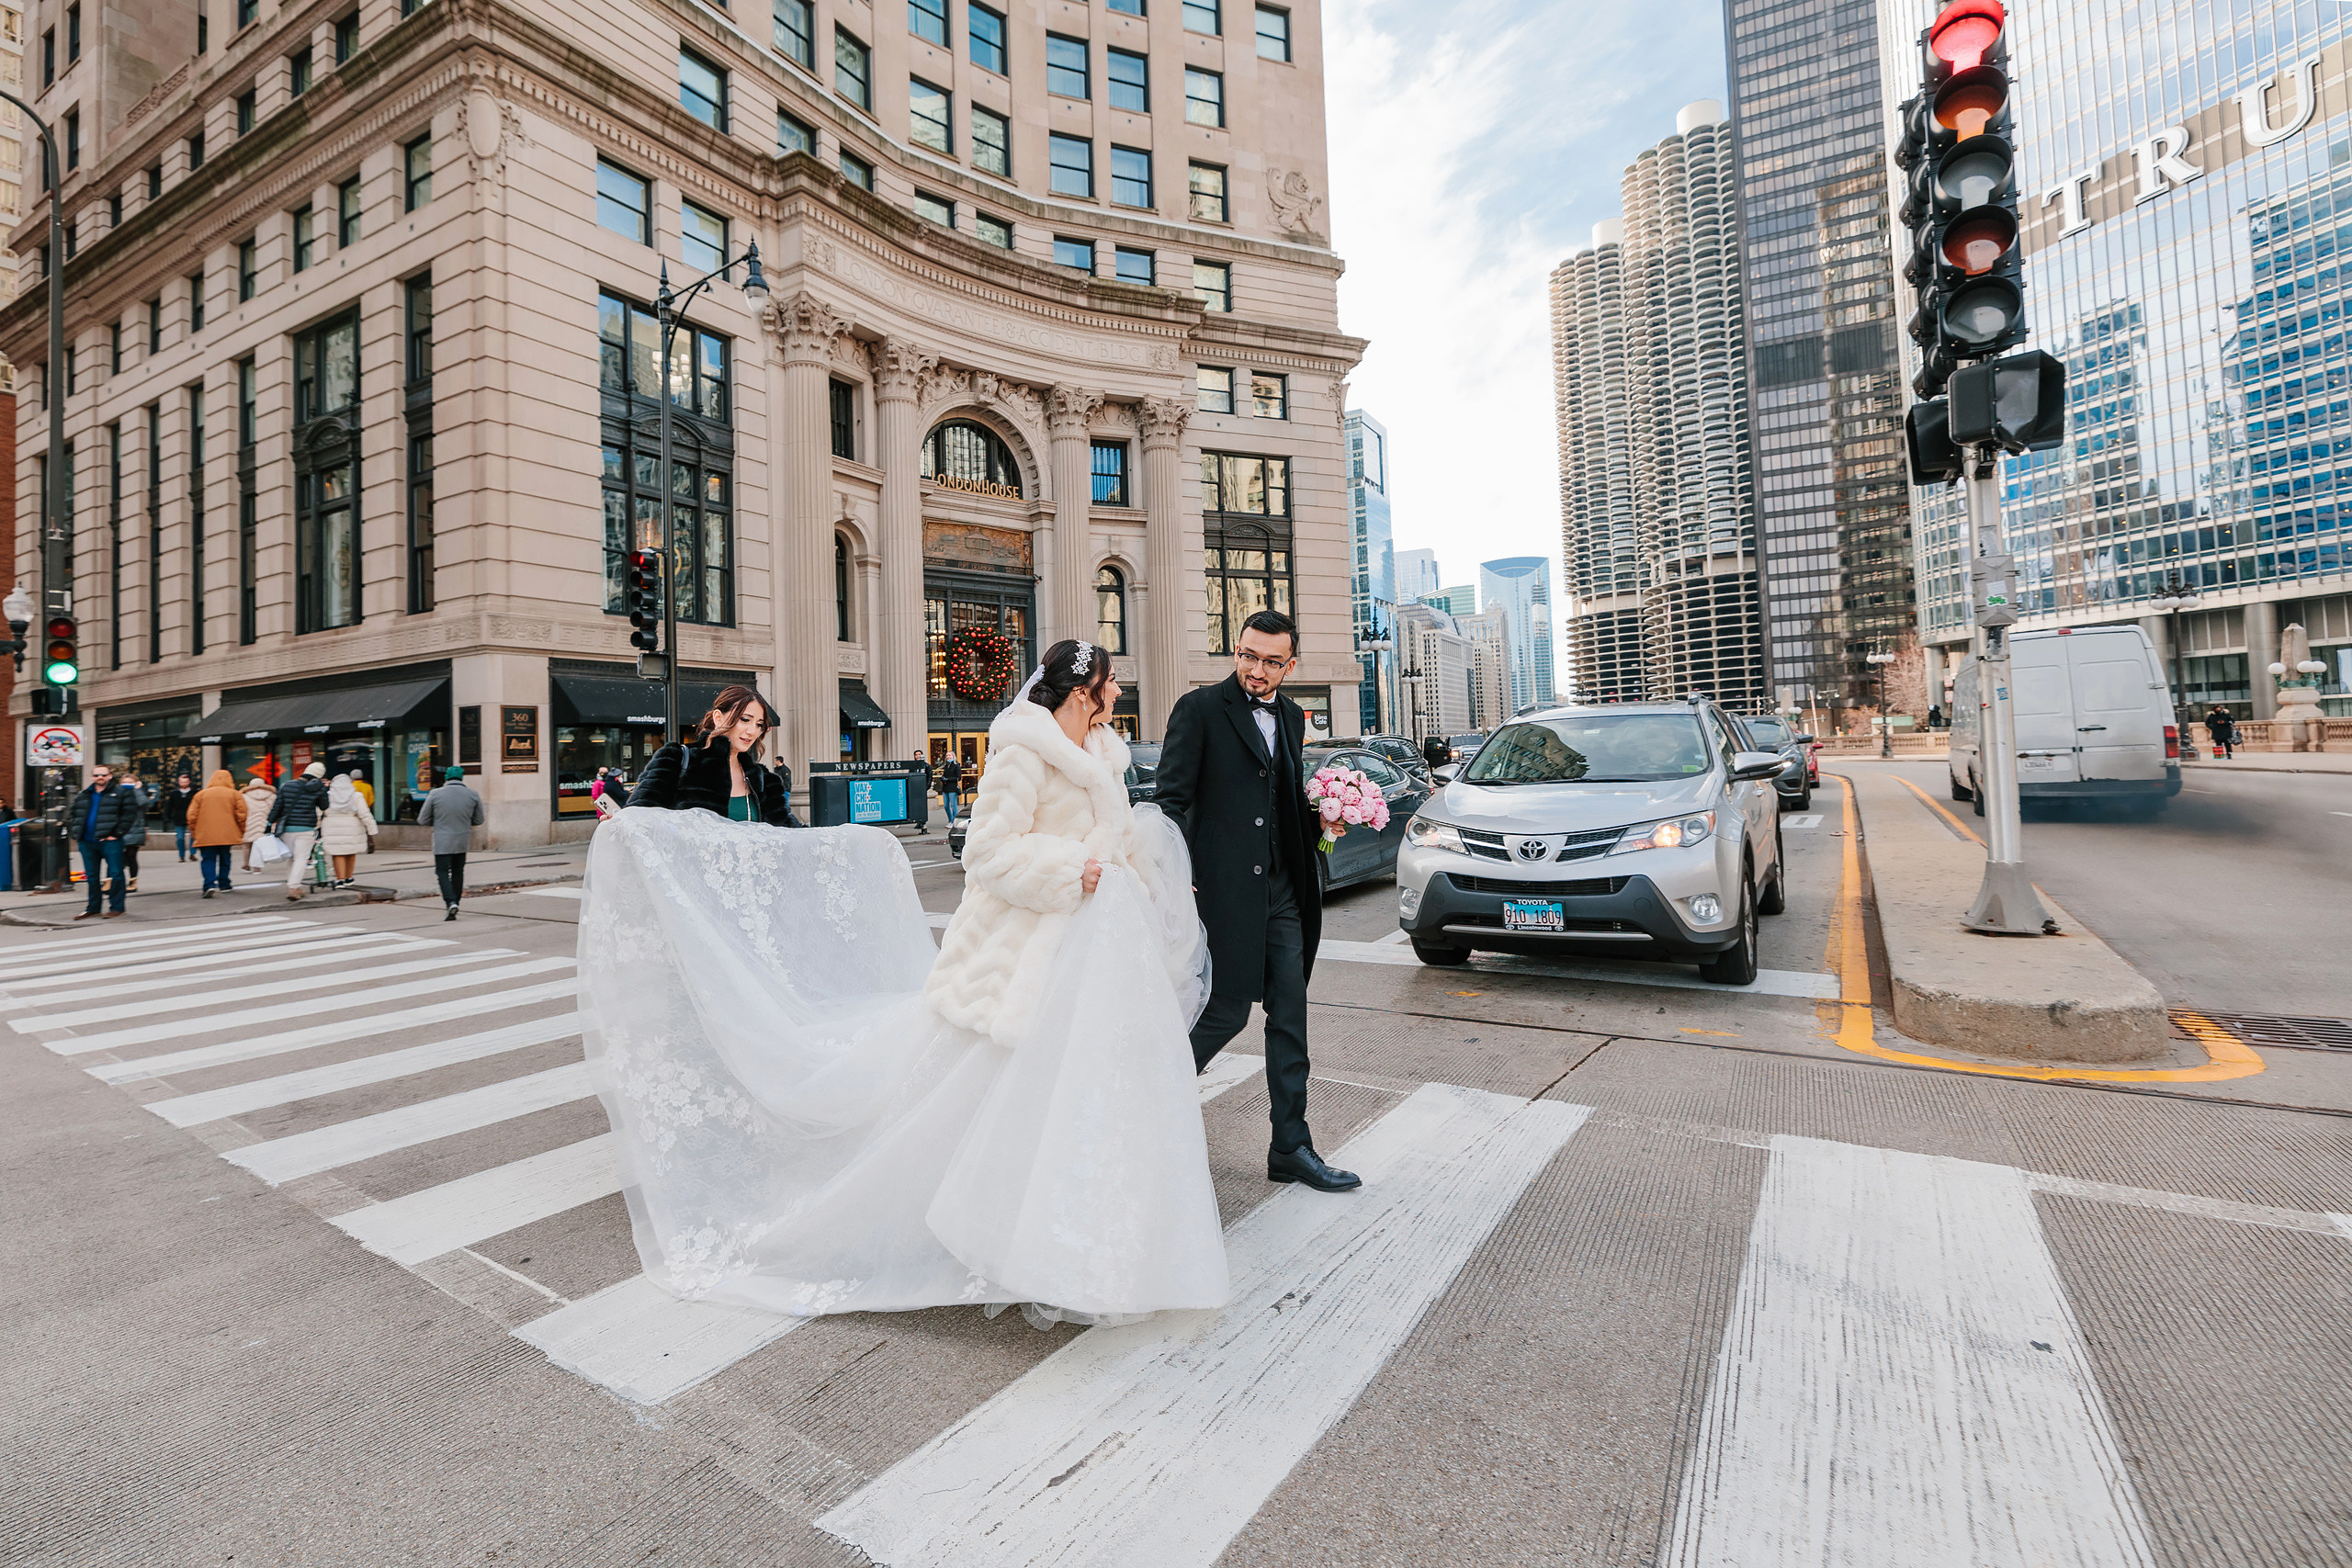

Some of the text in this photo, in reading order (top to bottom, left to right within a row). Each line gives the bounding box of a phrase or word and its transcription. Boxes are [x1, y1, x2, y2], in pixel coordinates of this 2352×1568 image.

[2041, 51, 2324, 241] TRU
[842, 256, 906, 302] LONDON
[1005, 322, 1015, 339] &
[1018, 329, 1093, 356] ACCIDENT
[931, 469, 1019, 500] LONDONHOUSE
[512, 713, 529, 722] 360
[408, 743, 429, 753] OPEN
[835, 762, 901, 771] NEWSPAPERS
[855, 783, 869, 794] VAX
[855, 802, 880, 813] NATION
[1506, 908, 1561, 924] 910 1809
